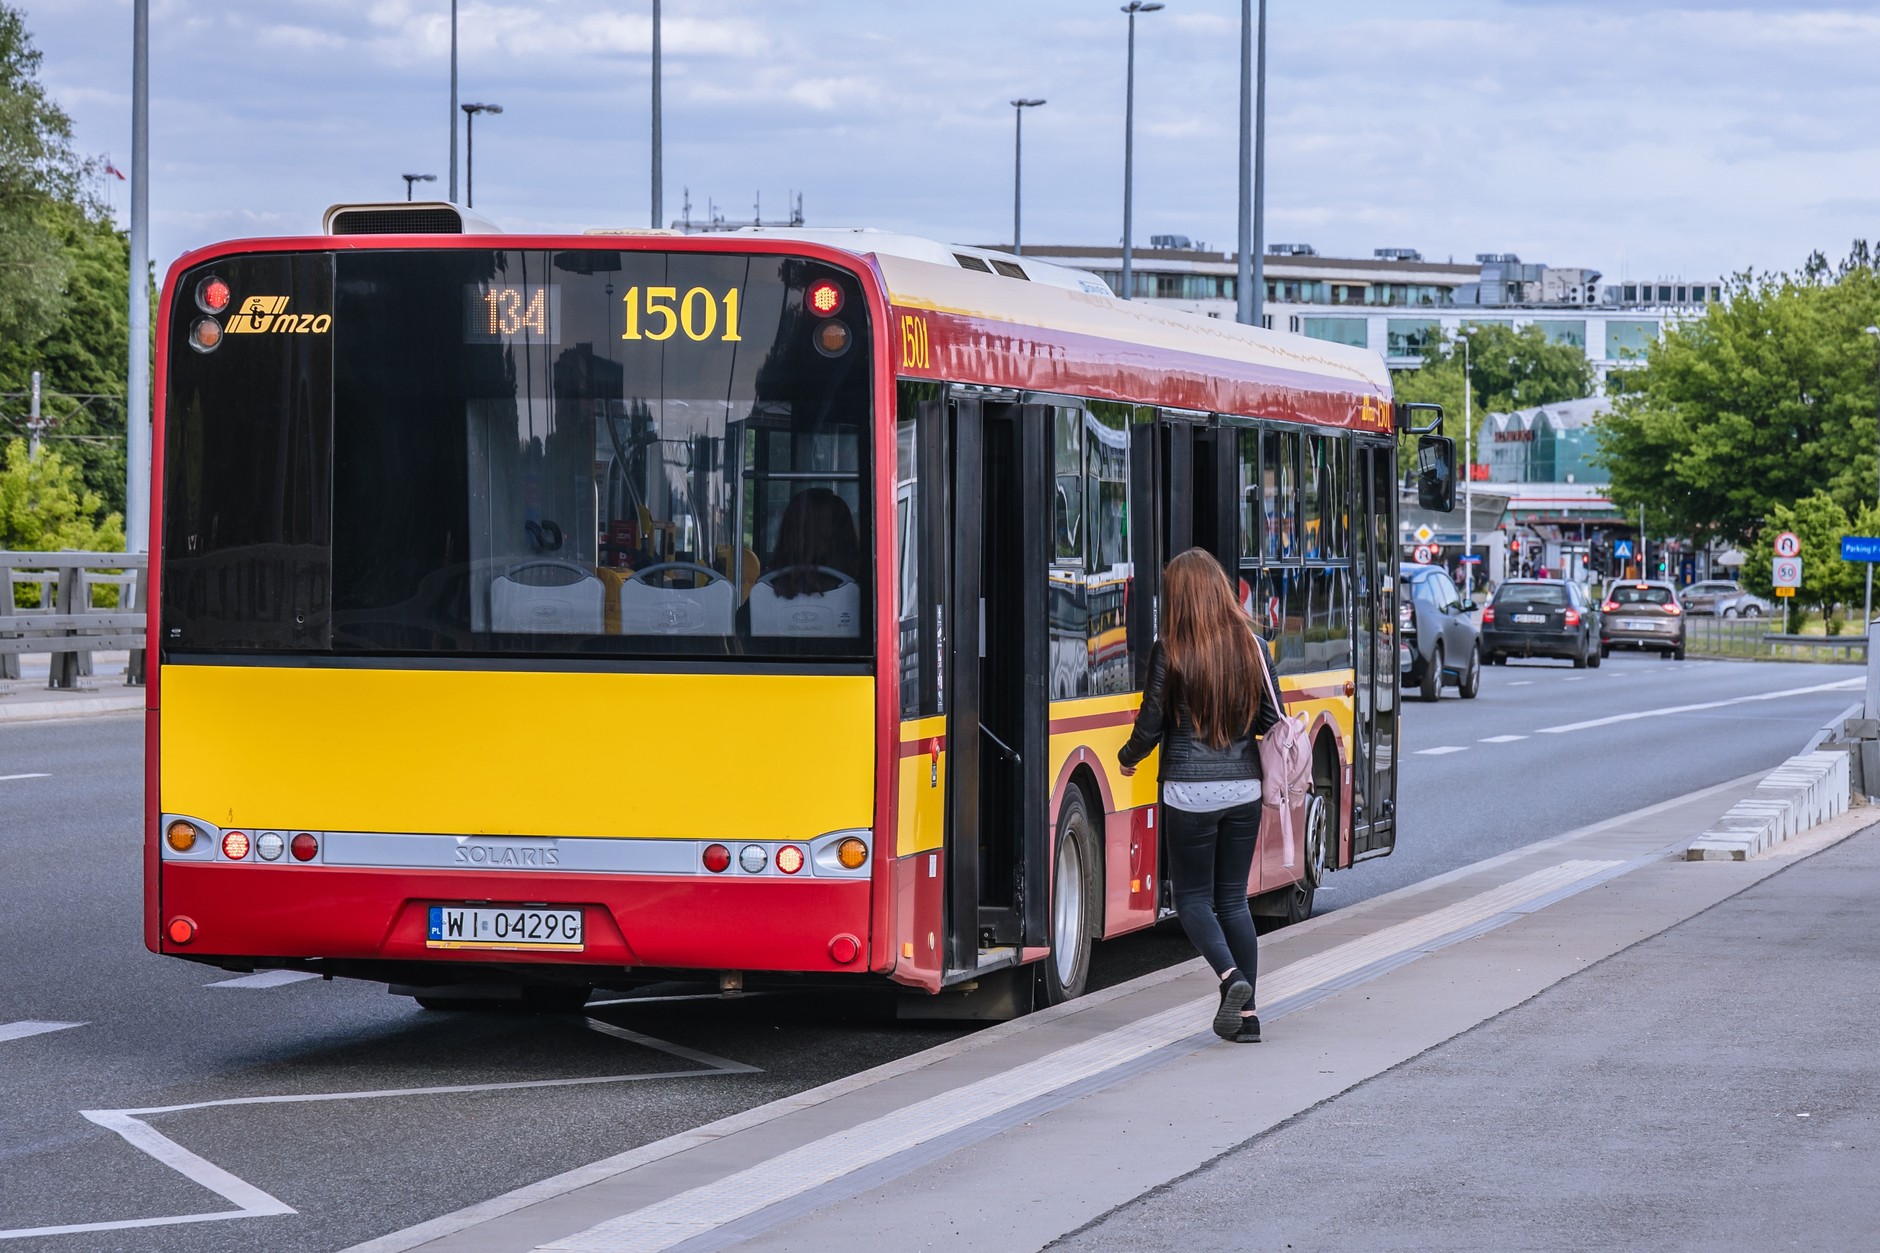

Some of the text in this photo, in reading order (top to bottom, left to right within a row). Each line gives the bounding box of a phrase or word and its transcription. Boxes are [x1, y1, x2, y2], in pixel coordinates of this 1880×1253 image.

[485, 289, 544, 335] 134
[622, 286, 742, 341] 1501
[271, 313, 332, 334] mza
[901, 315, 930, 369] 1501
[1845, 543, 1871, 555] Parking
[1781, 568, 1794, 577] 50
[454, 845, 559, 867] SOLARIS
[431, 927, 441, 935] PL
[447, 911, 577, 939] WI 0429G
